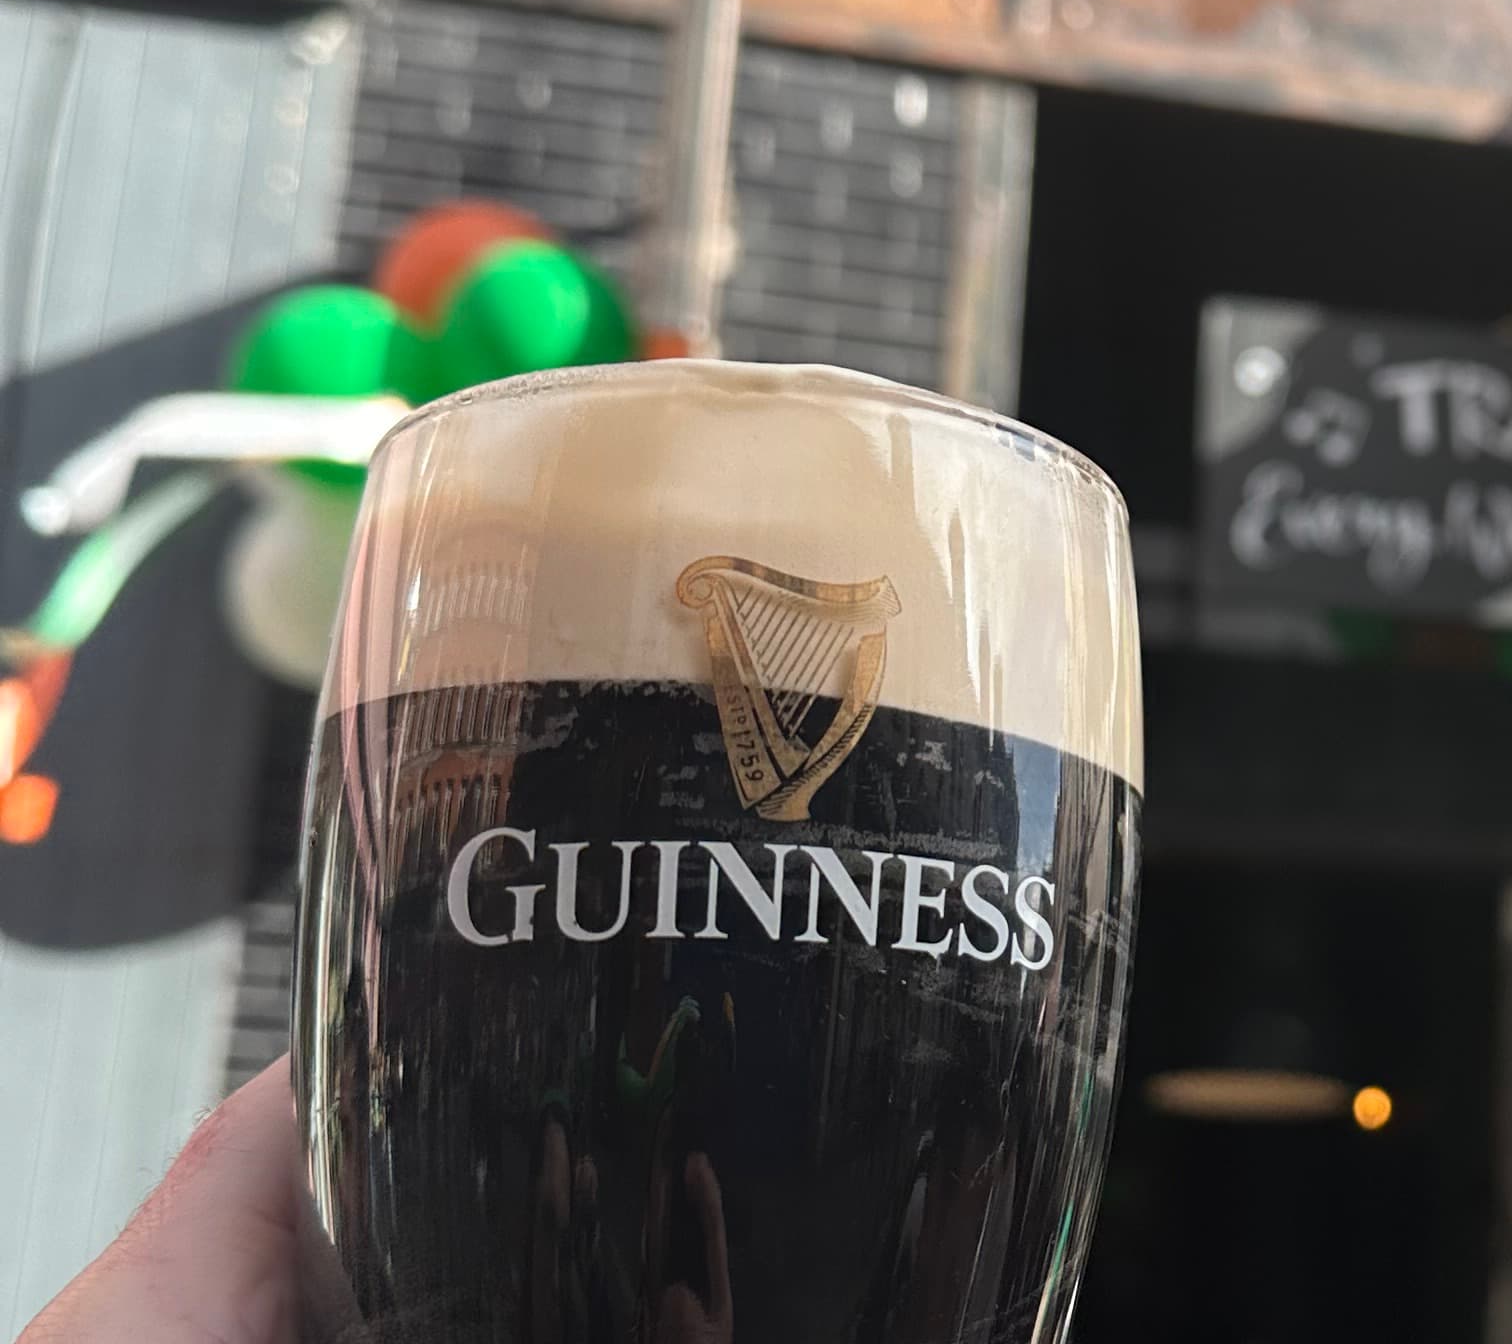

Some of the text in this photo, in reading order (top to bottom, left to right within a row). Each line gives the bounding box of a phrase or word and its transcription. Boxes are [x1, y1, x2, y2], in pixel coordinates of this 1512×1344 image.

[1229, 459, 1434, 596] Every
[732, 728, 765, 783] 1759
[446, 826, 1057, 972] GUINNESS
